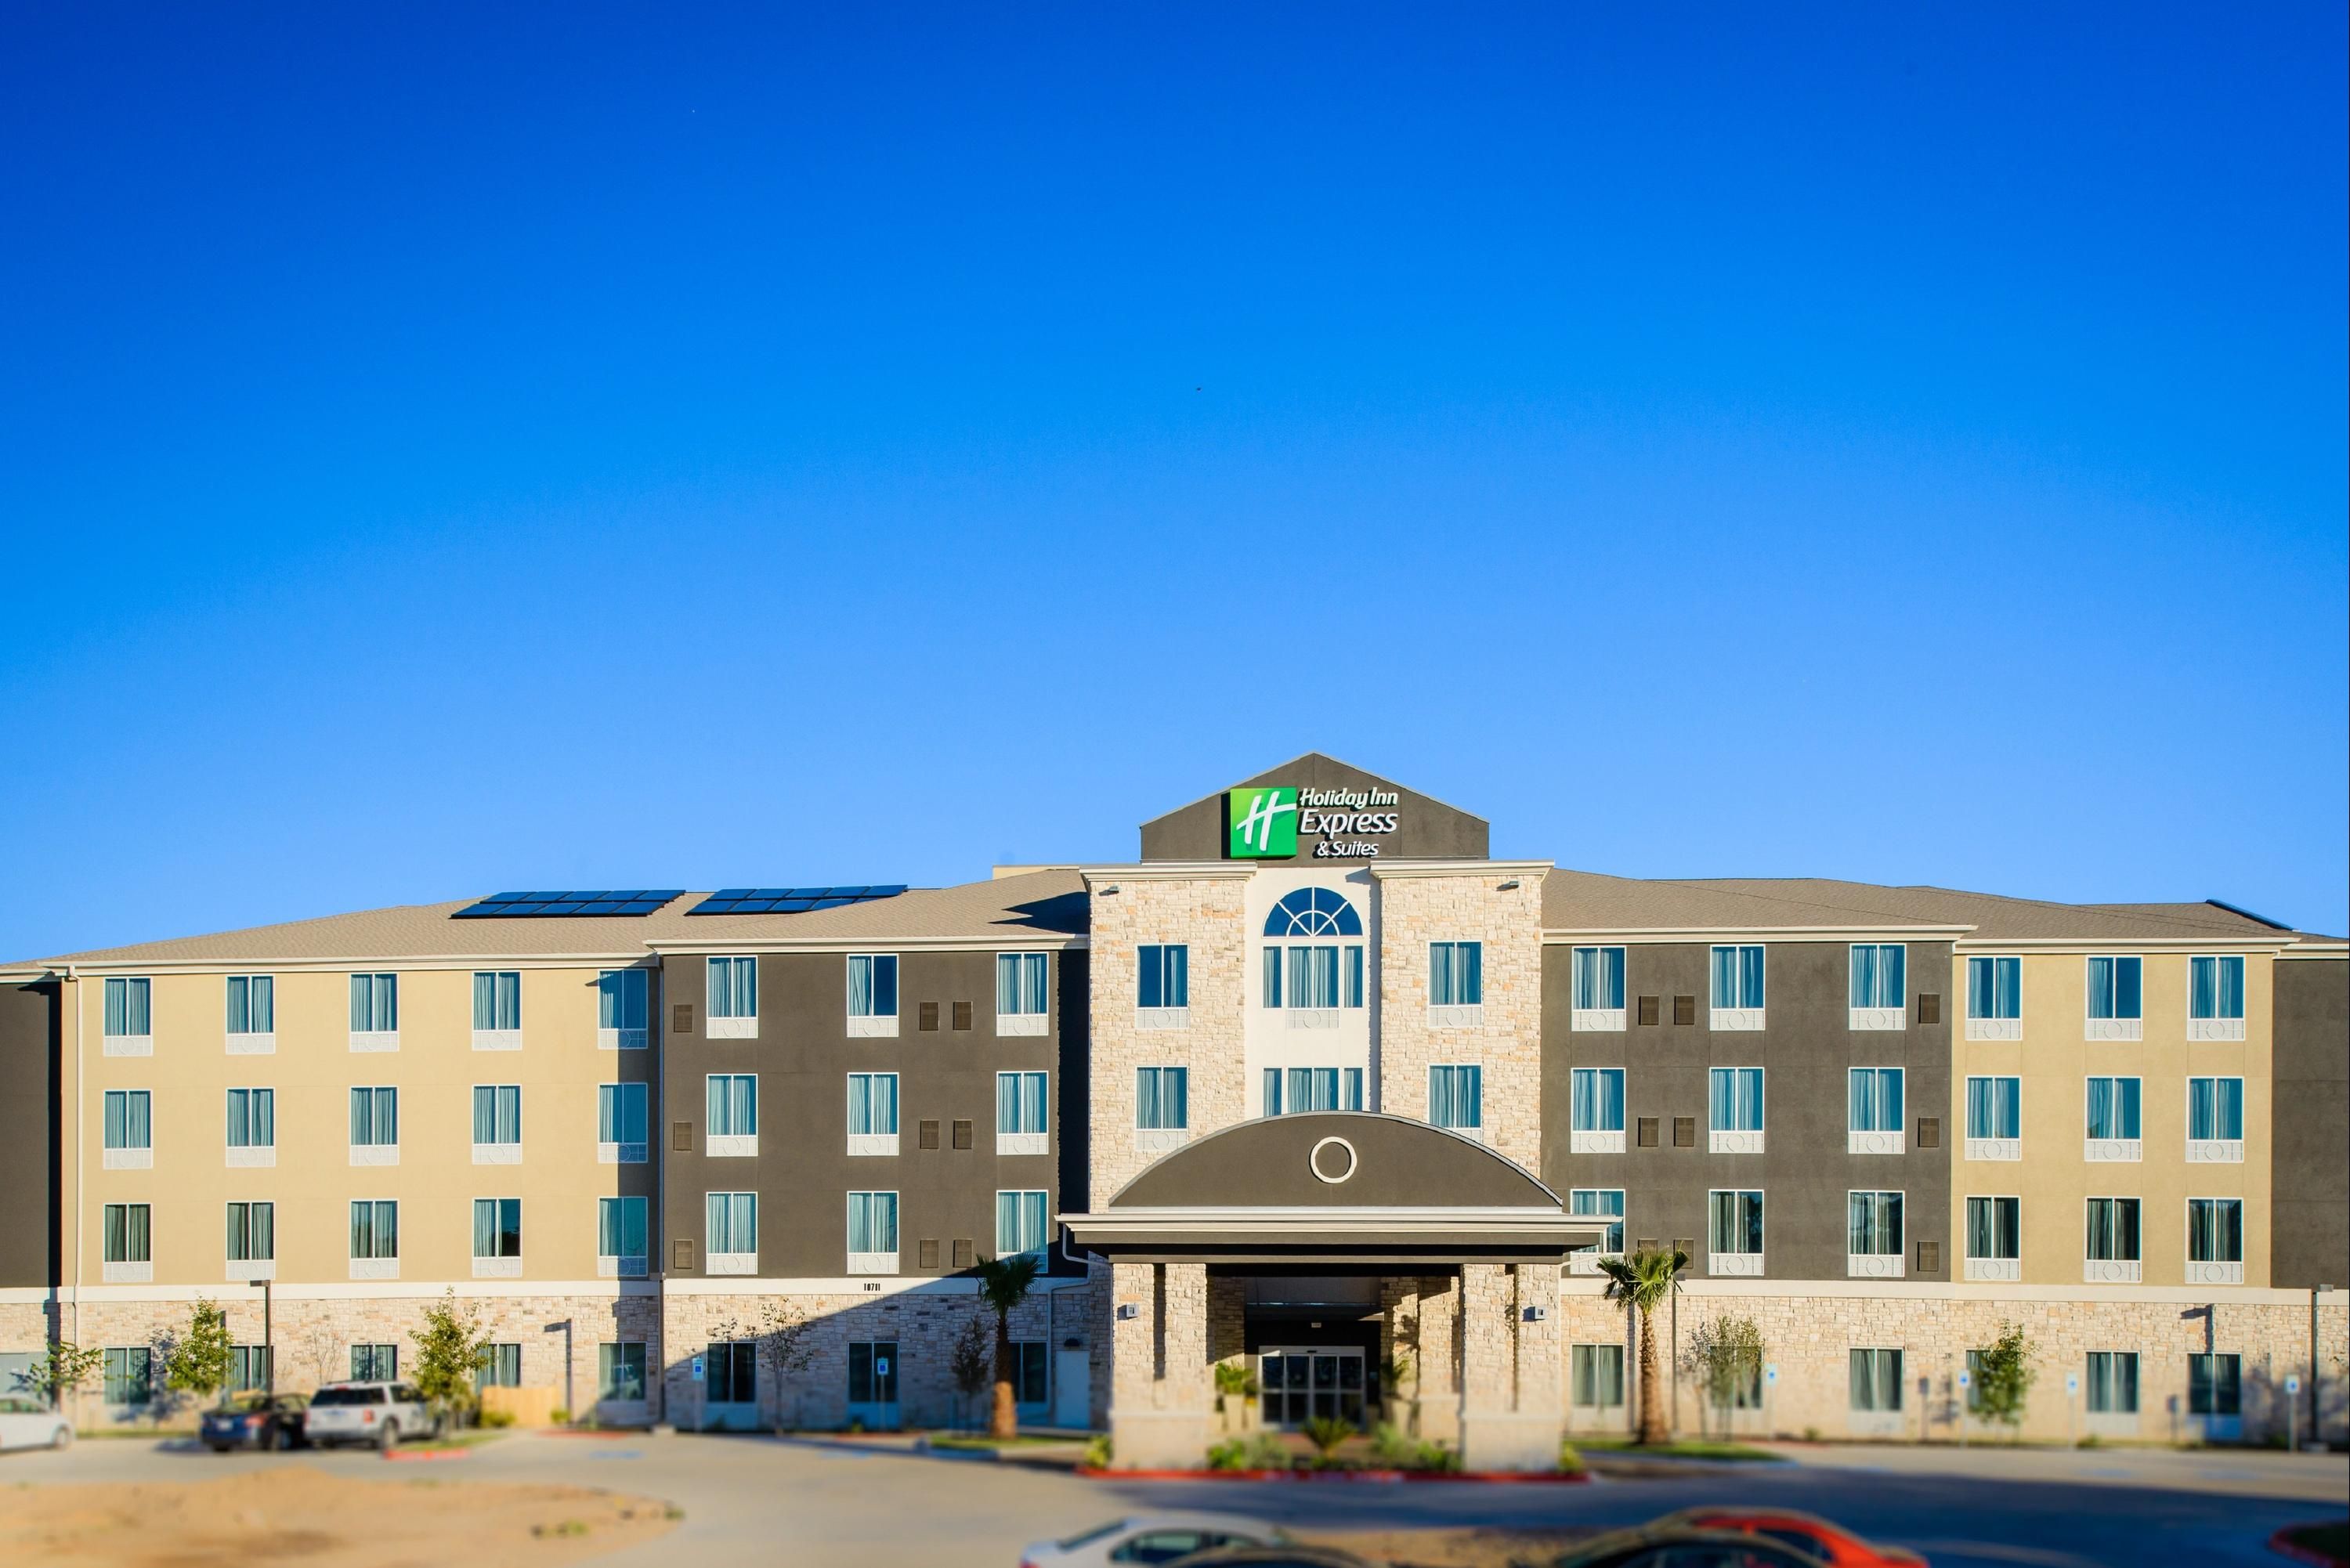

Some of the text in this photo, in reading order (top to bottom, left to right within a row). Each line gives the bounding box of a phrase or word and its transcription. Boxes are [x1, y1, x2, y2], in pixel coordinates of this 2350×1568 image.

[1300, 787, 1398, 810] Holiday Inn
[1236, 791, 1296, 851] H
[1300, 808, 1398, 840] Express
[1317, 840, 1379, 857] & Suites
